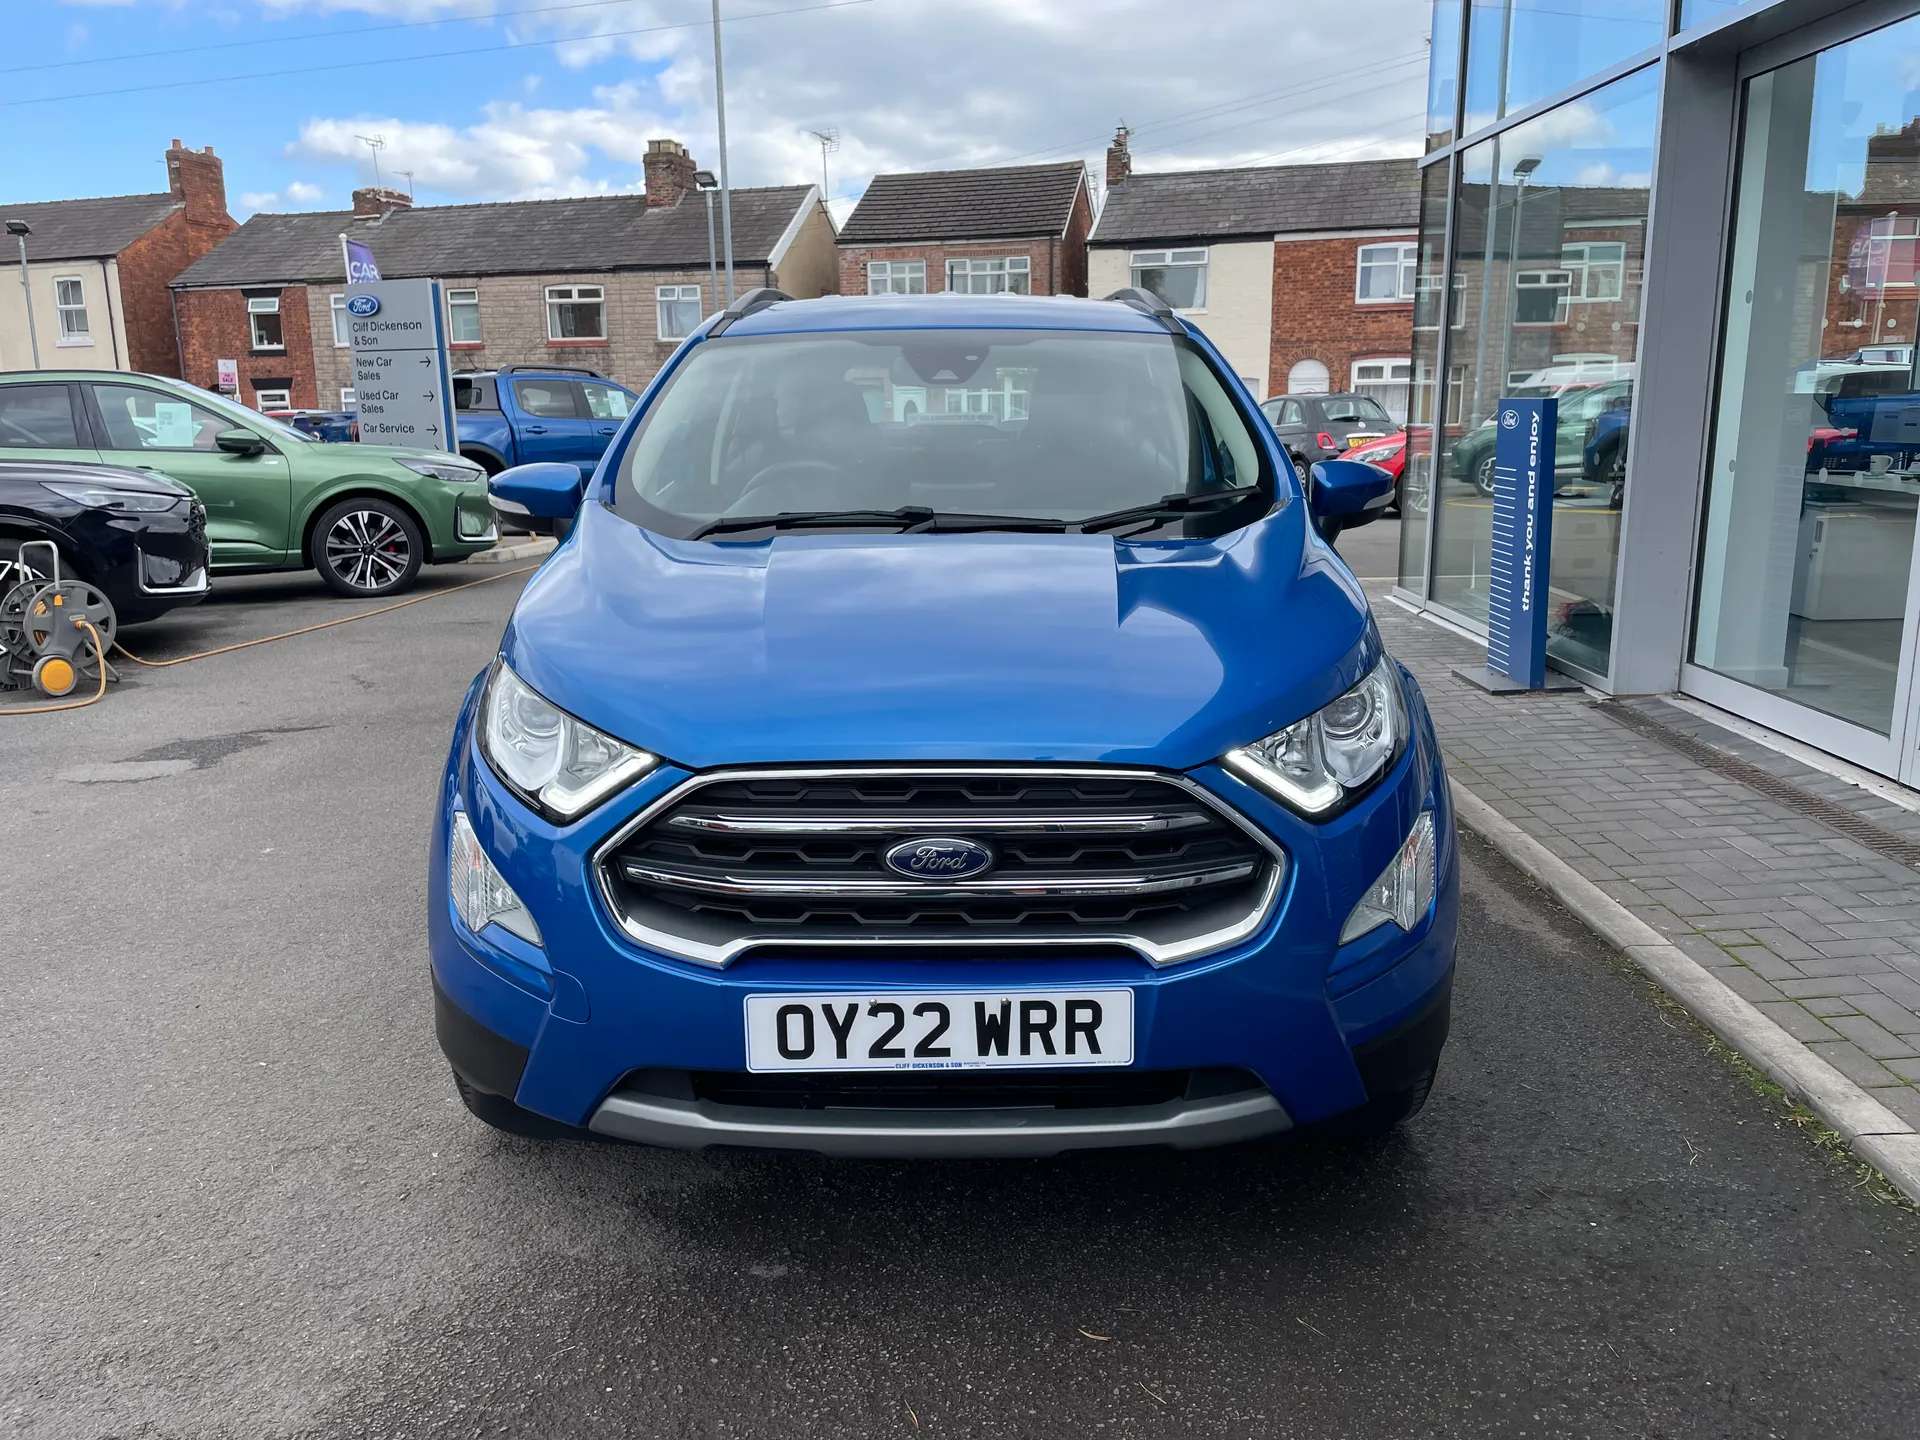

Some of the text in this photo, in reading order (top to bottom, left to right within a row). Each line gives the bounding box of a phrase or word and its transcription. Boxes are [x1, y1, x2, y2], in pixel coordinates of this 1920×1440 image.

[350, 261, 380, 279] CAR
[352, 298, 372, 313] Ford
[352, 320, 422, 333] Cliff Dickenson
[354, 335, 378, 346] & Son
[356, 356, 392, 368] New Car
[358, 370, 381, 381] Sales
[360, 390, 399, 401] Used Car
[361, 403, 385, 414] Sales
[363, 423, 415, 433] Car Service
[1522, 410, 1540, 612] thank you and enjoy
[911, 846, 968, 870] Ford
[775, 998, 1103, 1060] OY22 WRR
